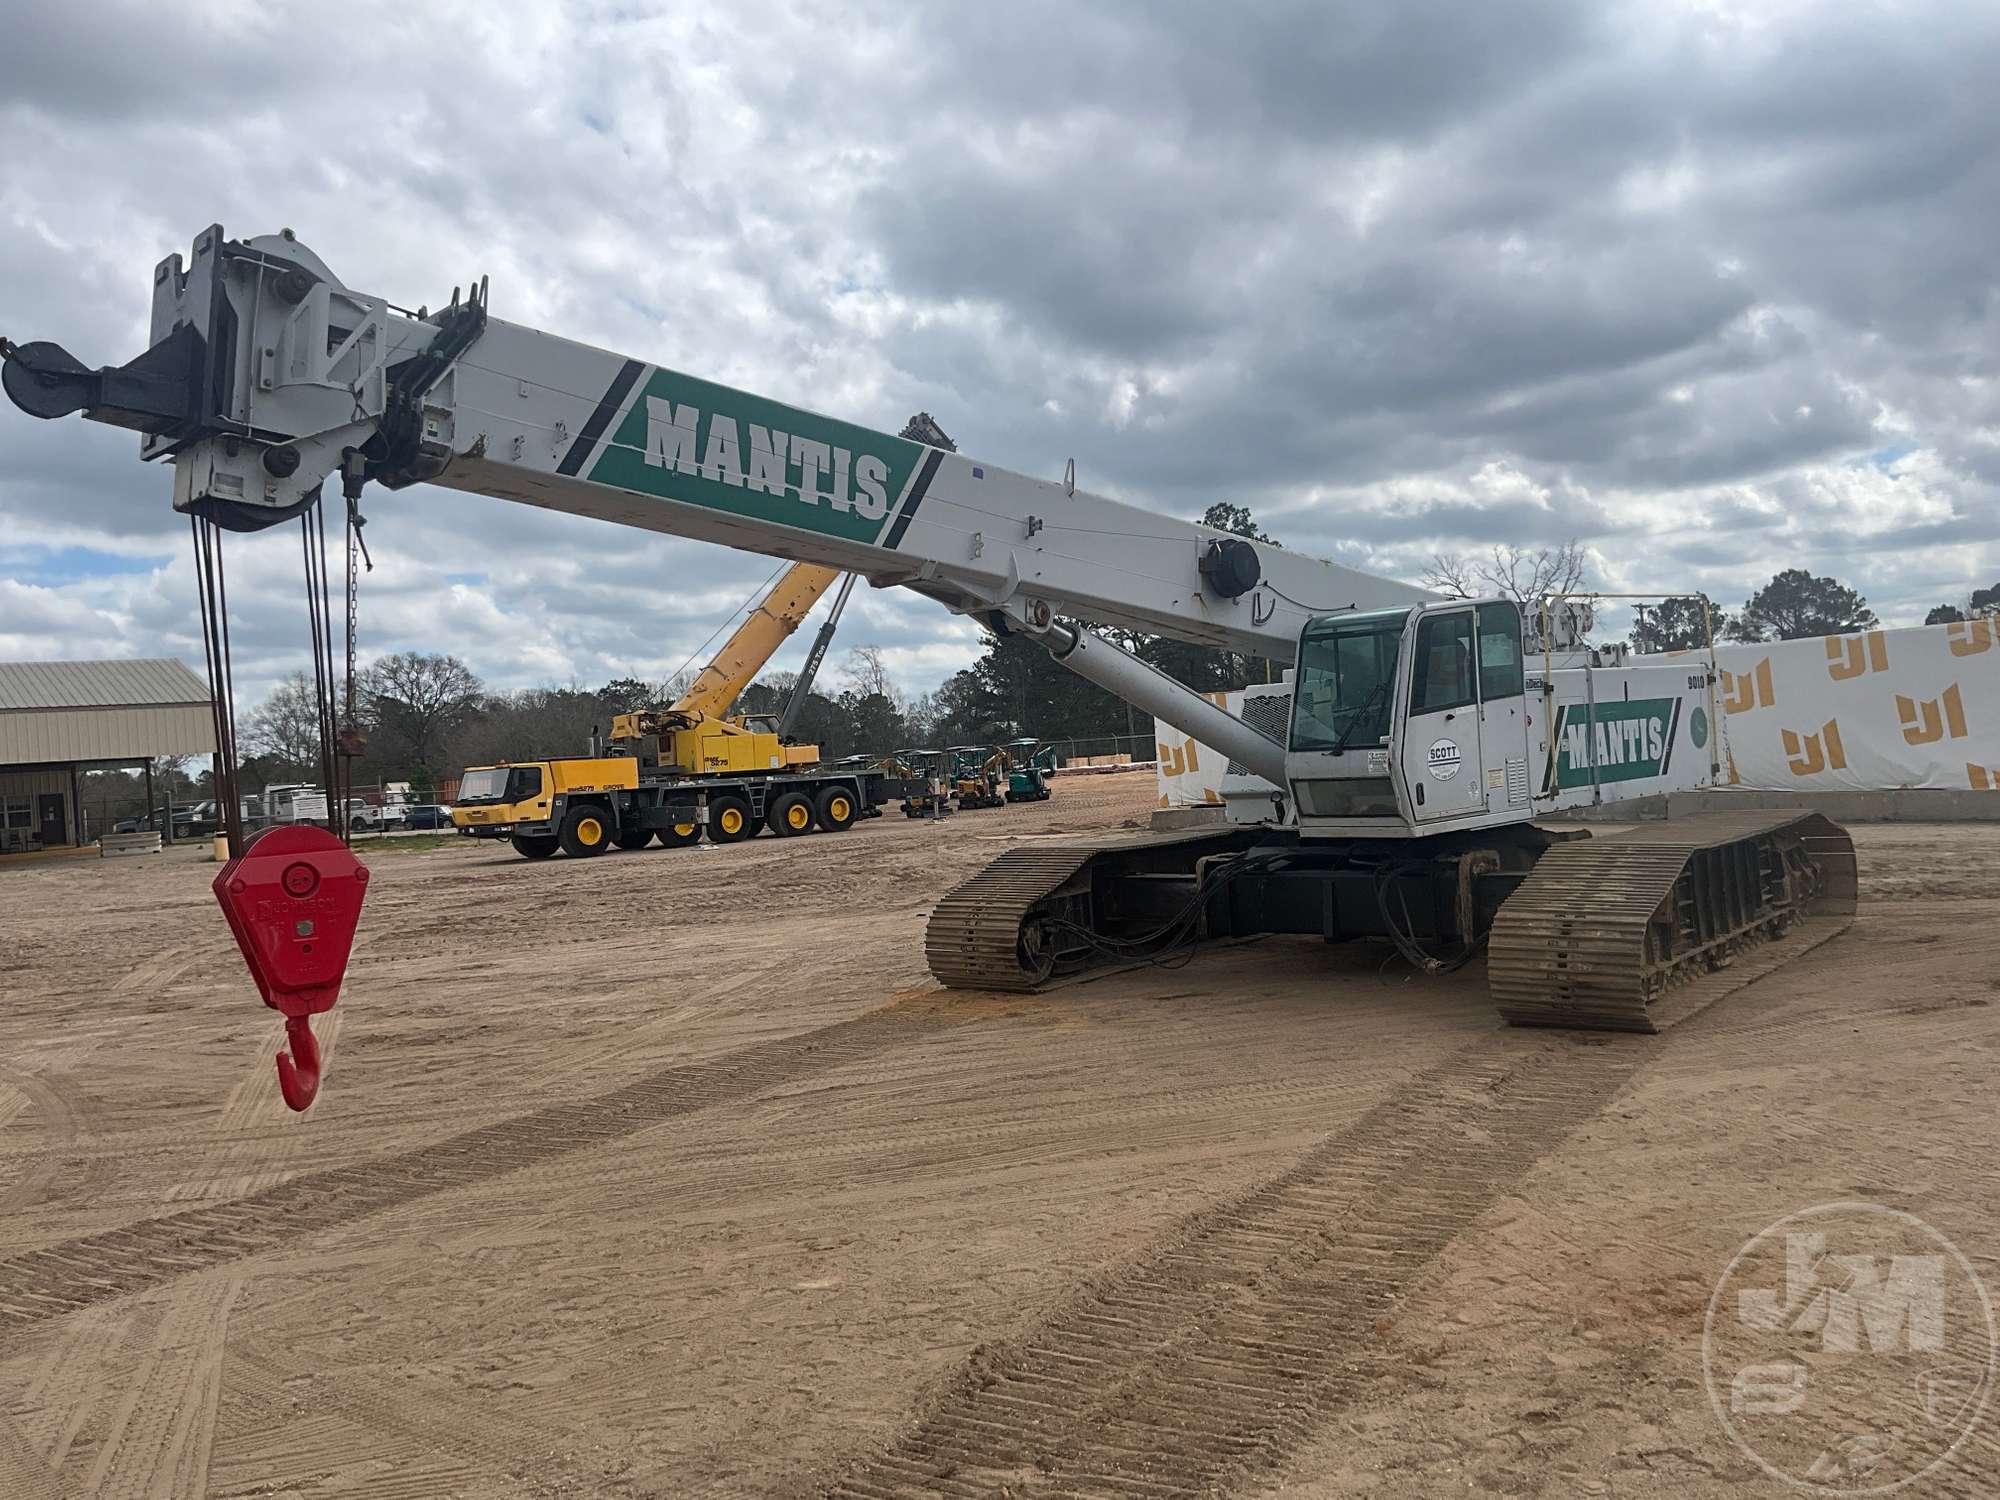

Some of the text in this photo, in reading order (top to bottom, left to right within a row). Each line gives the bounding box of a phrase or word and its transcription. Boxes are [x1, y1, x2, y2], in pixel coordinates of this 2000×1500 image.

[644, 395, 888, 520] MANTIS
[808, 659, 819, 676] 275
[1687, 675, 1705, 690] 9010
[1567, 717, 1662, 770] MANTIS
[1430, 746, 1457, 760] SCOTT
